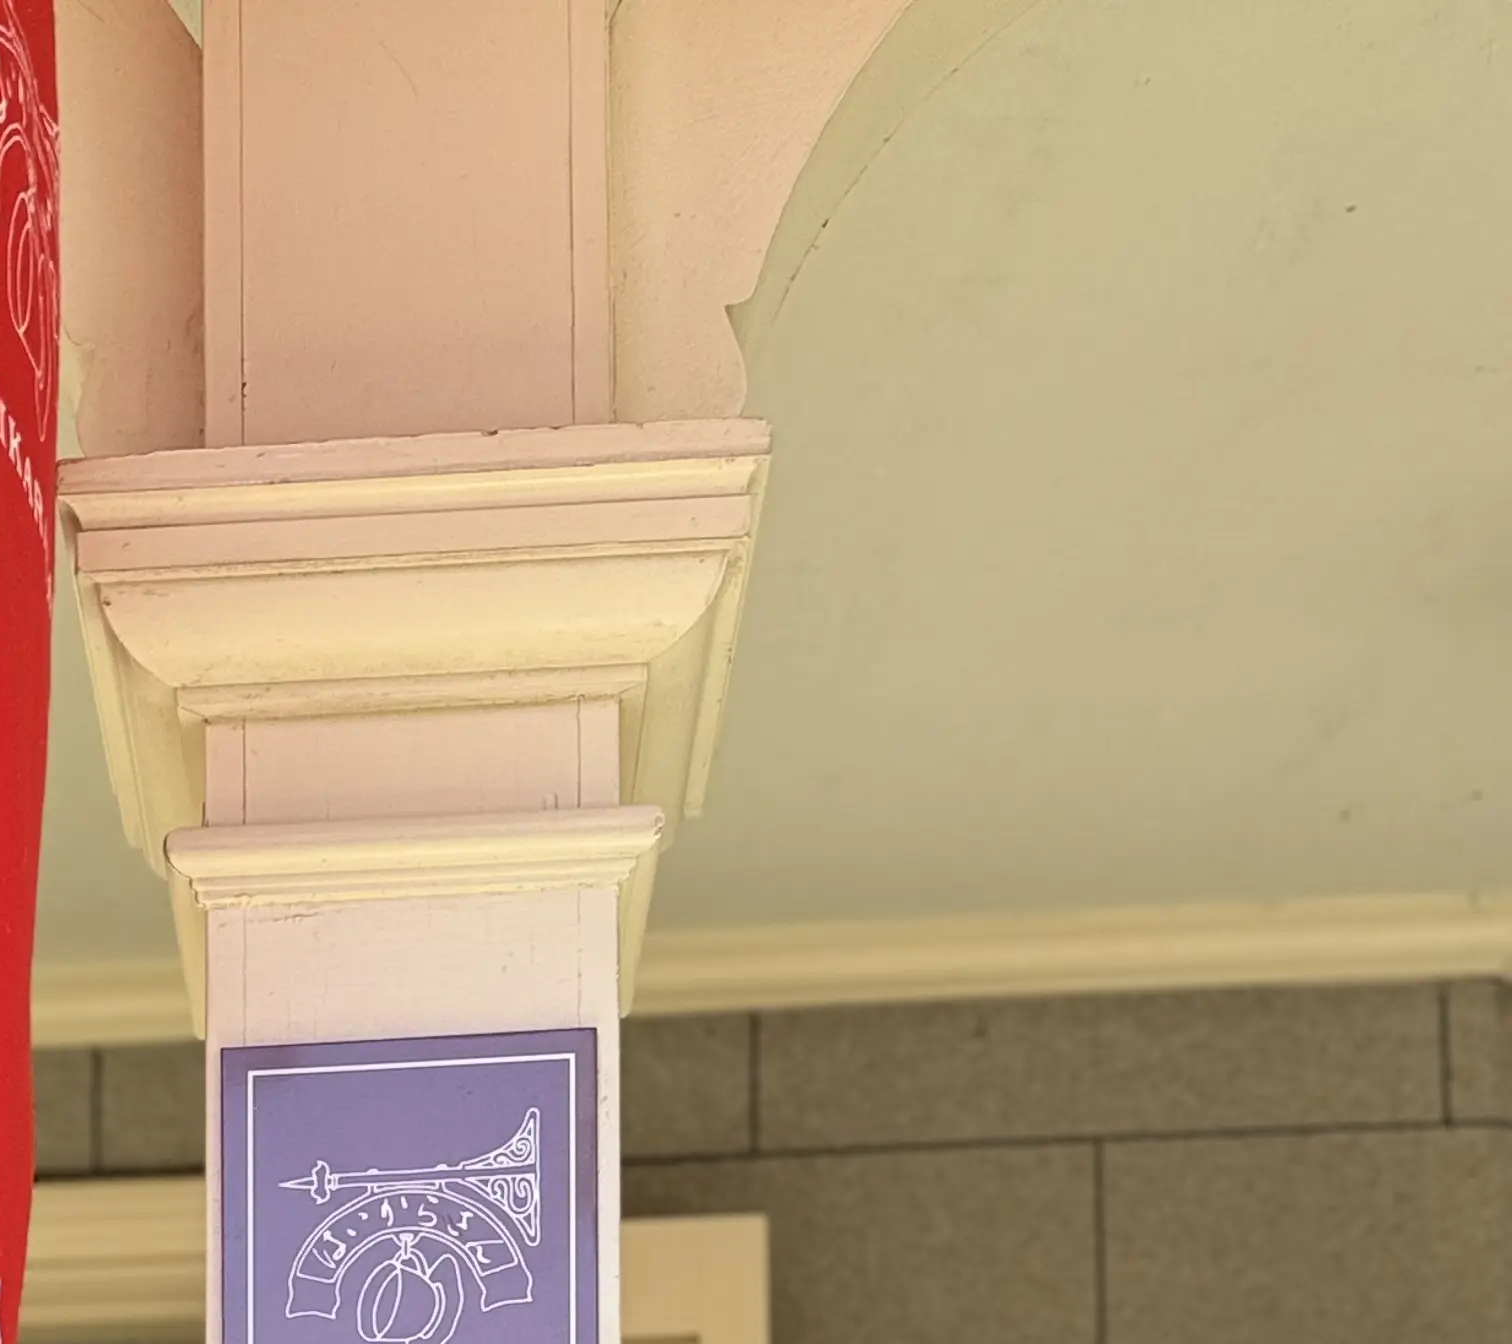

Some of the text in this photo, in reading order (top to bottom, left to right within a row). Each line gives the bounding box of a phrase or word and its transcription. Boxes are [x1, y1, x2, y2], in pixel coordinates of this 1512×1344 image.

[311, 1195, 505, 1269] はいからさん
